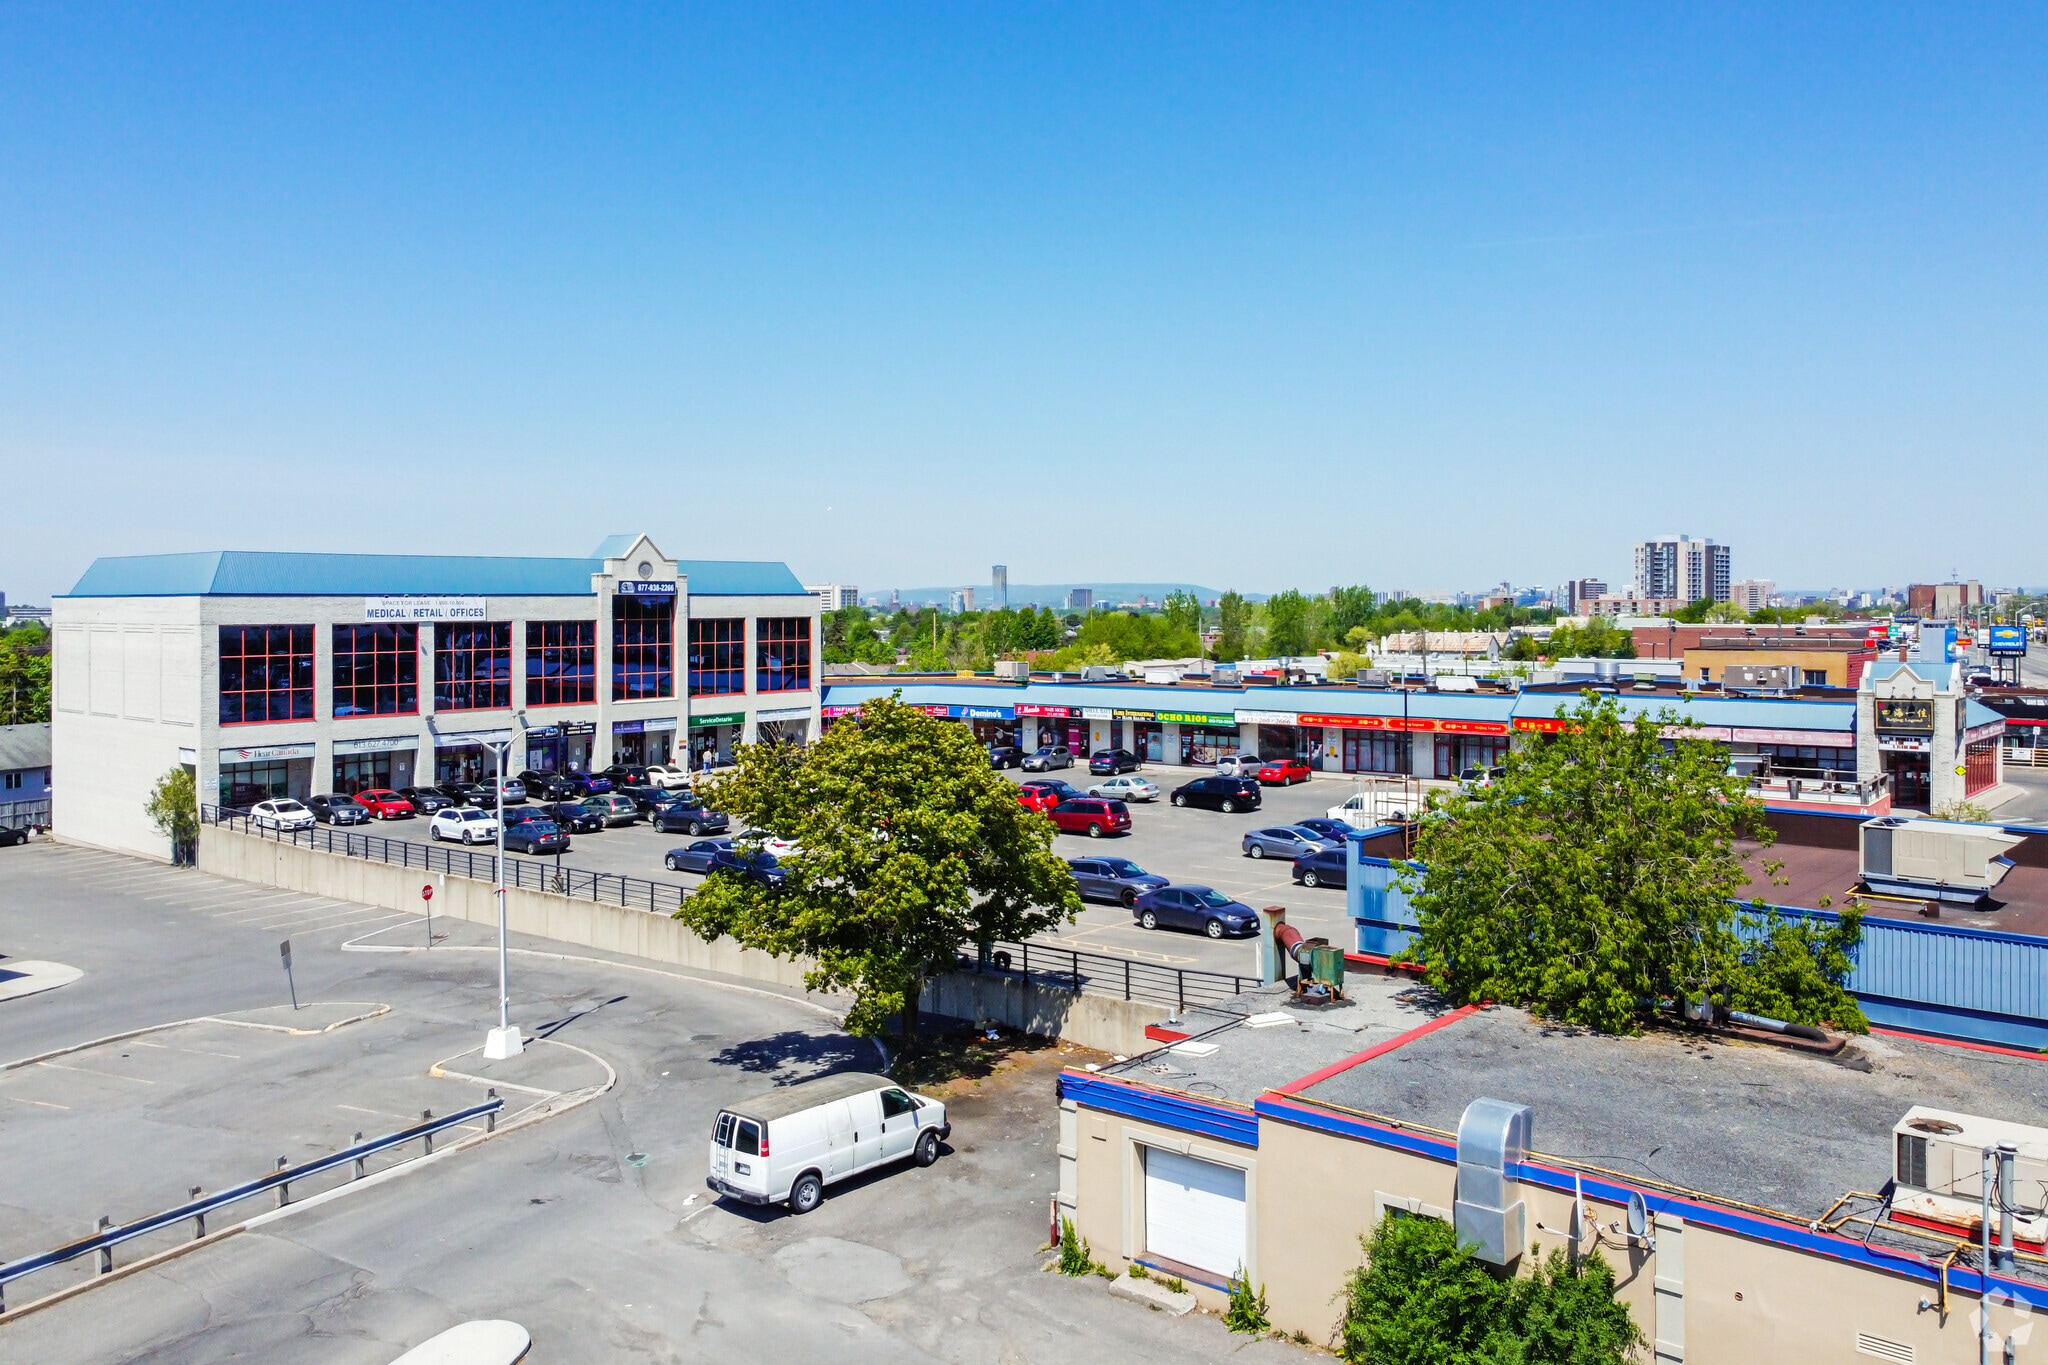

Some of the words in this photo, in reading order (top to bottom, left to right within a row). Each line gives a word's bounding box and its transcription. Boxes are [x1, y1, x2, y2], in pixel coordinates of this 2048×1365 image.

[367, 609, 406, 618] MEDICAL
[413, 609, 443, 618] RETAIL
[450, 608, 484, 617] OFFICES
[970, 709, 1002, 718] Domino's
[1157, 712, 1183, 721] OCHO
[1184, 714, 1207, 723] RIOS
[699, 716, 733, 724] ServiceOntario
